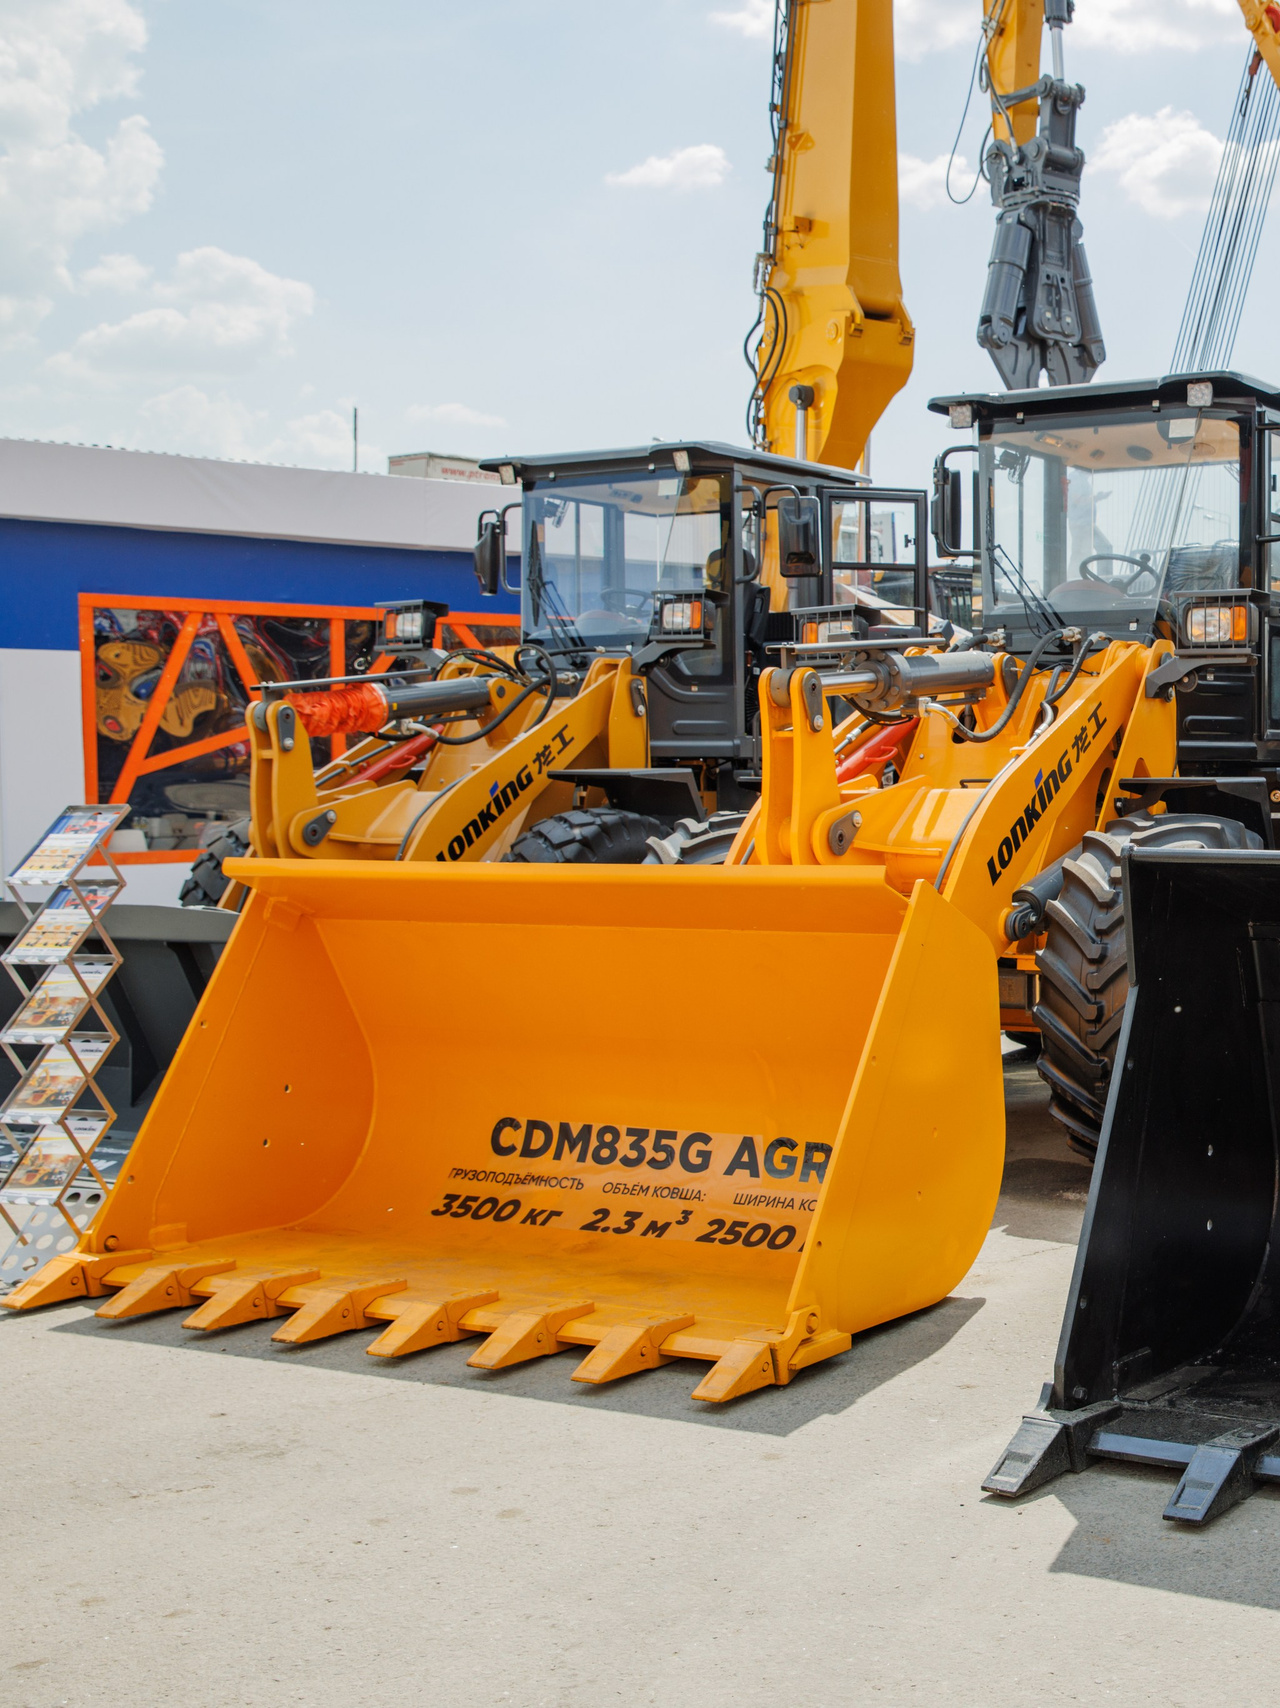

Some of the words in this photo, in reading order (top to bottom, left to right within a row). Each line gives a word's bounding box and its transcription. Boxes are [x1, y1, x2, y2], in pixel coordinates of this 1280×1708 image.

[491, 1117, 713, 1174] CDM835G
[448, 1167, 585, 1191] ГРУЗОПОДЪЁМНОСТЬ
[651, 1185, 707, 1202] КОВША:
[732, 1192, 795, 1210] ШИРИНА
[431, 1193, 521, 1222] 3500
[519, 1207, 563, 1226] кг
[579, 1207, 644, 1234] 2.3
[695, 1218, 797, 1250] 2500
